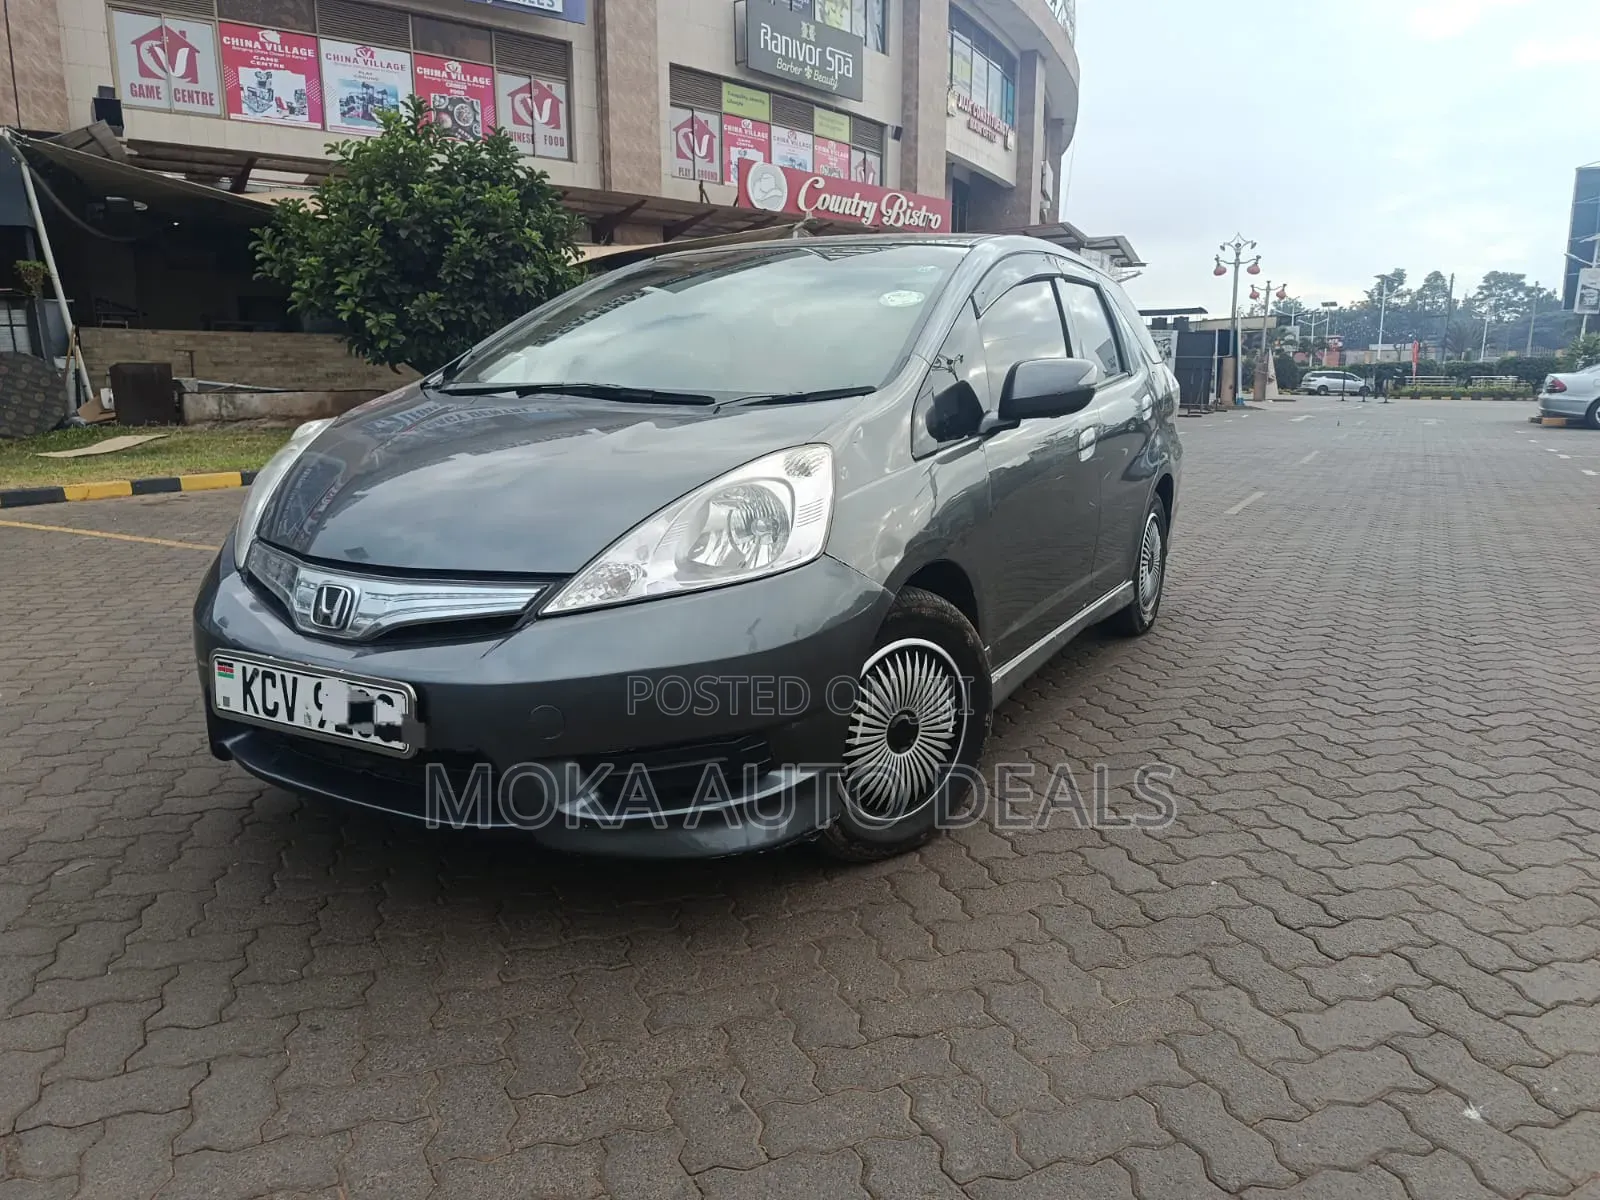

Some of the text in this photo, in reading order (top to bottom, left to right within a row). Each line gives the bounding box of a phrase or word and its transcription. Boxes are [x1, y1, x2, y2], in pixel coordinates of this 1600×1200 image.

[223, 36, 315, 58] CHINA VILLAGE
[253, 55, 279, 63] GAME
[325, 52, 359, 65] CHINA
[363, 58, 407, 72] VILLAGE
[826, 46, 853, 80] Spa
[416, 66, 492, 86] CHINA VILLAGE
[776, 58, 838, 90] Barber Beauty
[129, 82, 215, 106] GAME CENTRE
[543, 134, 565, 147] FOOD
[723, 123, 743, 134] CHINA
[744, 128, 769, 140] VILLAGE
[797, 176, 942, 230] Country Bistro
[241, 665, 298, 722] KCV
